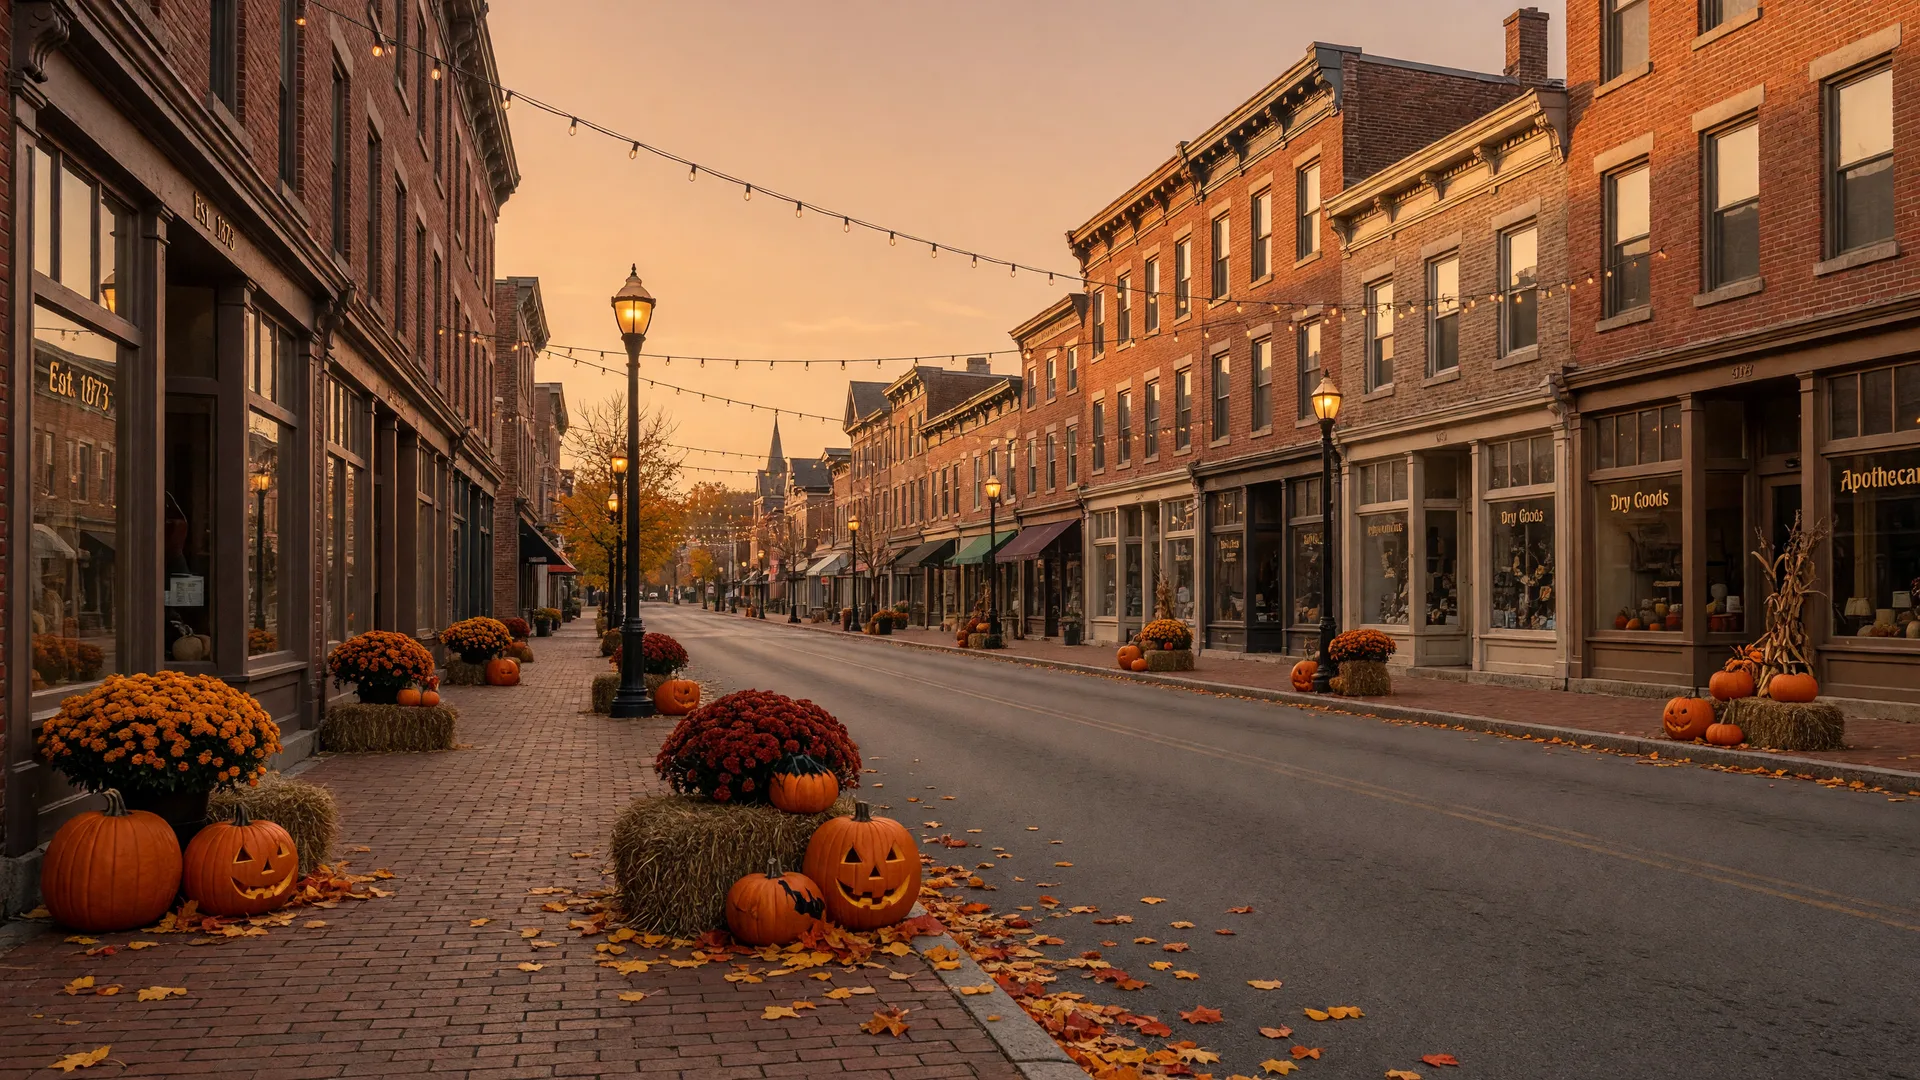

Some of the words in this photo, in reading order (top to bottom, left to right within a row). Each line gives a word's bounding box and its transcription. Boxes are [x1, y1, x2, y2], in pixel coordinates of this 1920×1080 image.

[81, 374, 109, 411] 1873
[1610, 494, 1630, 513] Dry
[1634, 489, 1669, 509] Goods
[1501, 511, 1517, 527] Dry
[1519, 508, 1544, 523] Goods
